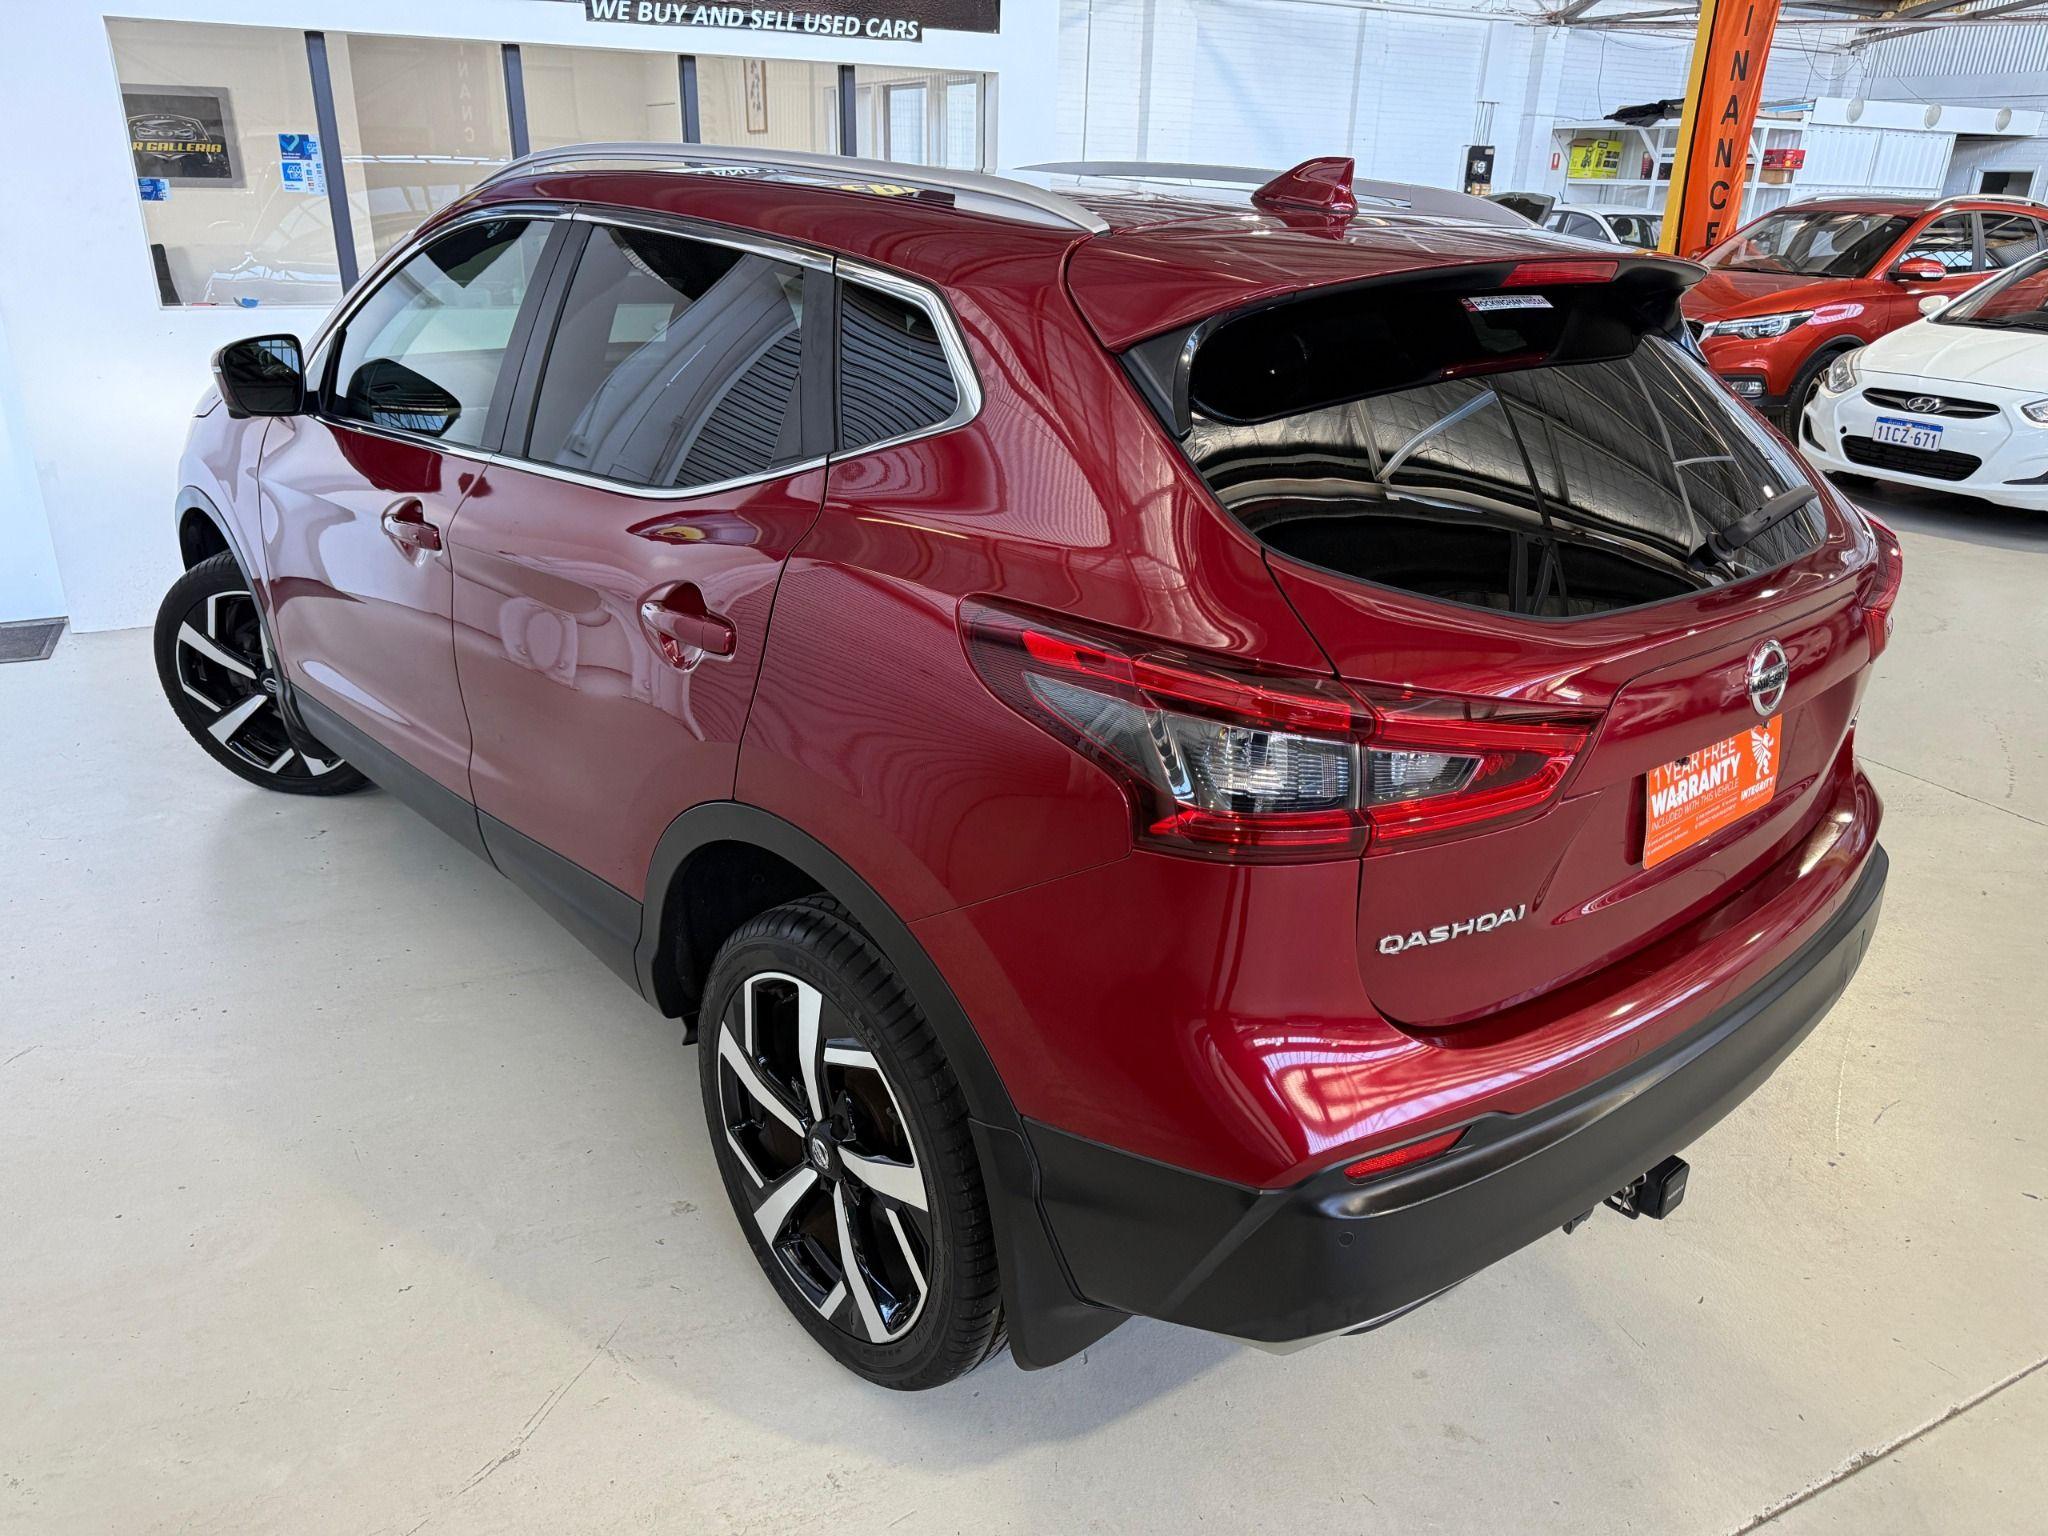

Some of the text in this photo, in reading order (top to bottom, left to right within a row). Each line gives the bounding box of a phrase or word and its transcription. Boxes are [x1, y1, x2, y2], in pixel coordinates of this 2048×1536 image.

[591, 0, 919, 39] WE BUY AND SELL USED CARS
[146, 142, 222, 153] GALLERIA
[1651, 752, 1741, 819] WARRANTY
[1654, 737, 1736, 790] 1 YEAR FREE
[1741, 775, 1775, 801] INTEGRITY
[1651, 807, 1683, 831] INCLUDED
[1684, 799, 1700, 816] WITH
[1700, 791, 1714, 806] THIS
[1714, 777, 1740, 799] VEHICLE
[1377, 903, 1526, 955] QASHQAI
